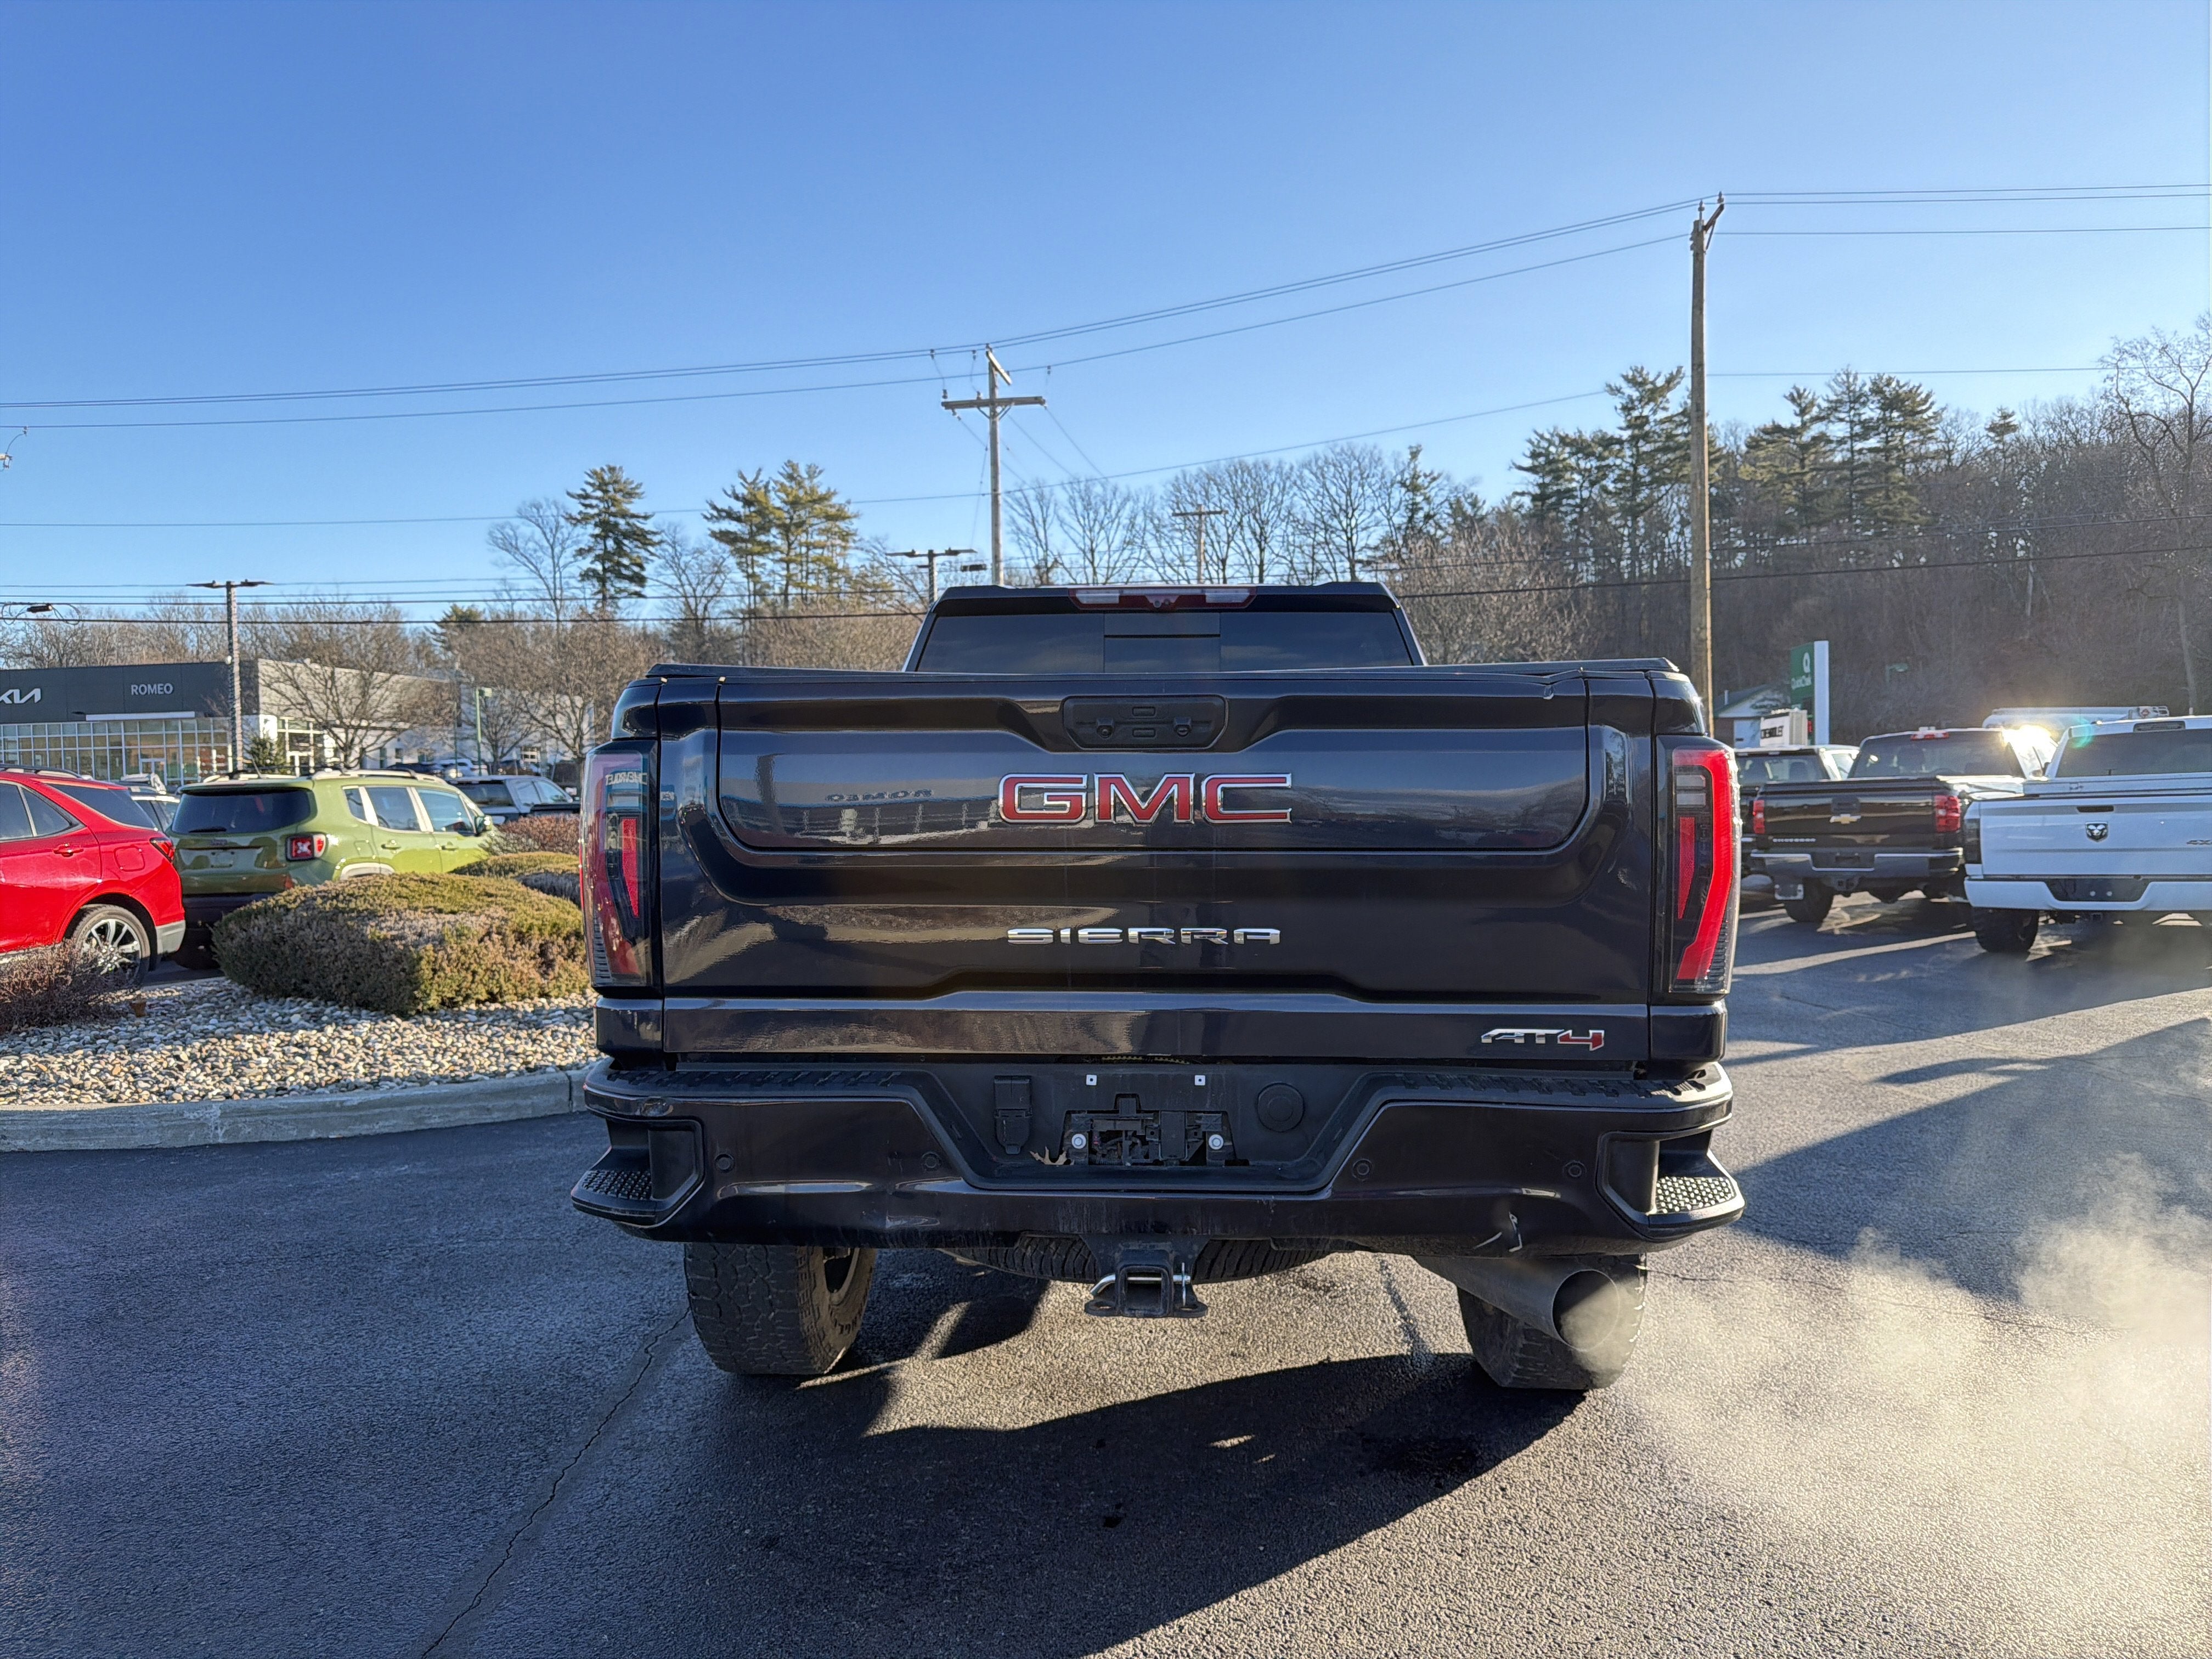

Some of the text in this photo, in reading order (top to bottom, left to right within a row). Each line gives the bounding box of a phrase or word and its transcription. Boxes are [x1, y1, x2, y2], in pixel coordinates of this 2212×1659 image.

[131, 683, 173, 696] ROMEO
[998, 772, 1293, 824] GMC
[1007, 928, 1281, 945] SIERRA
[1481, 1029, 1605, 1052] AT4
